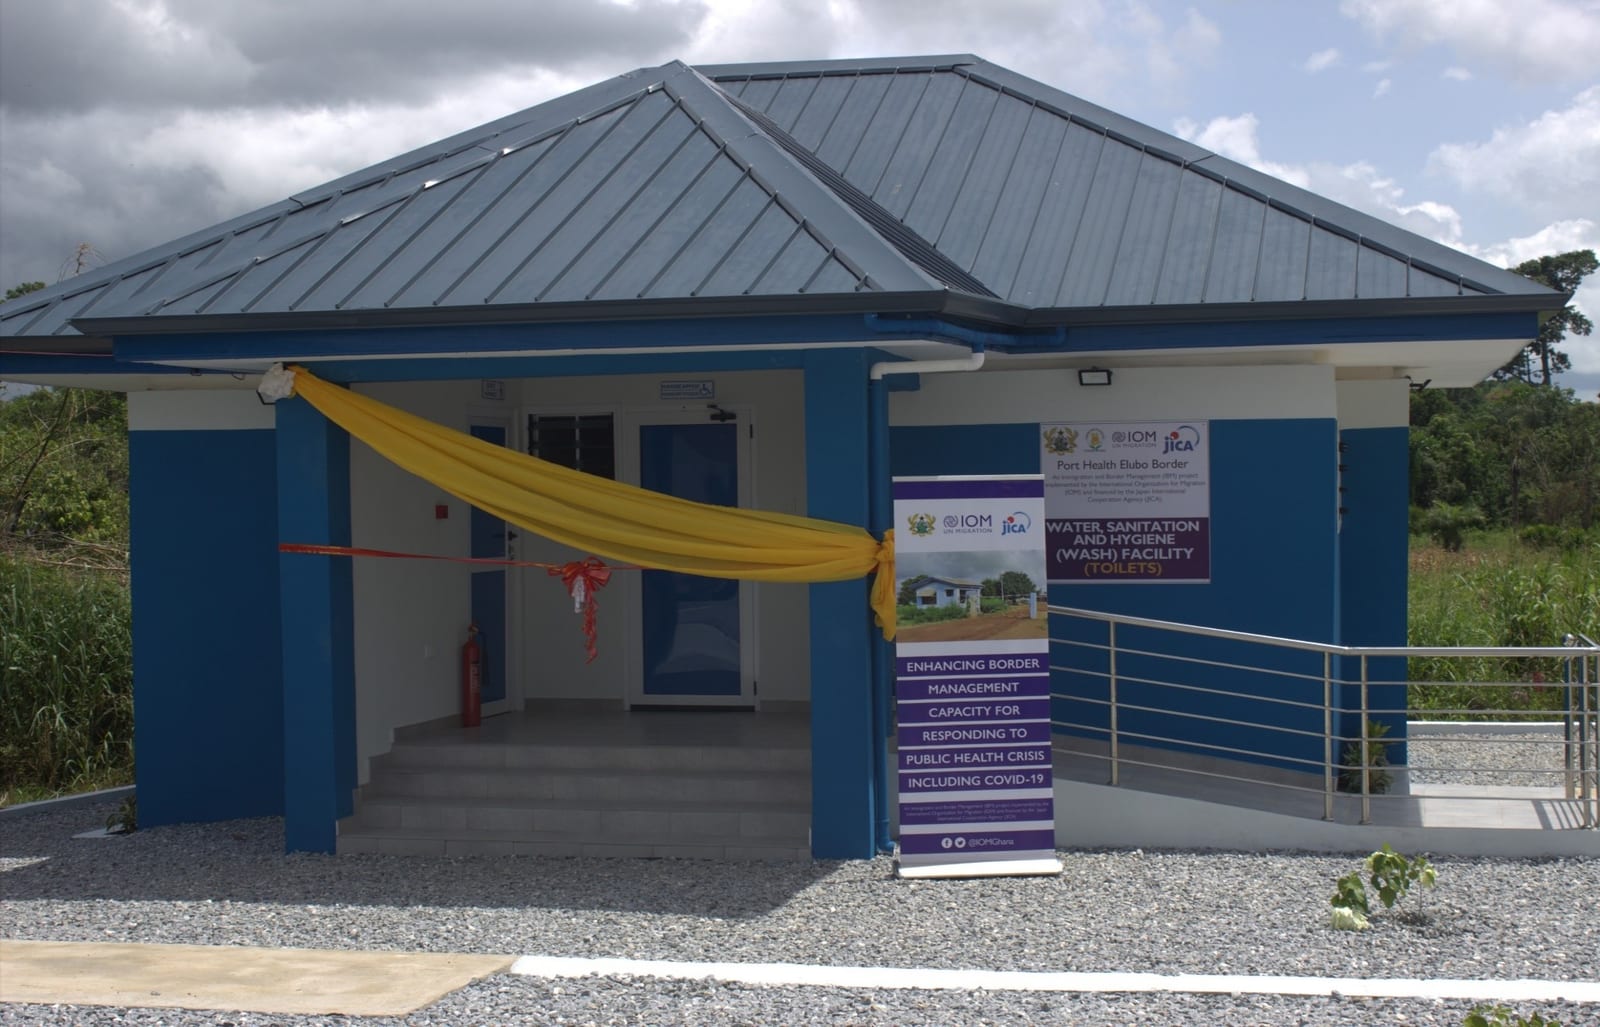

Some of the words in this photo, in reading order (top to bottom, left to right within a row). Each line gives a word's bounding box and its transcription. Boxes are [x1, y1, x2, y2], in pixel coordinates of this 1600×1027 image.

[1128, 431, 1156, 442] IOM
[1058, 460, 1080, 470] Port
[1083, 460, 1116, 470] Health
[1120, 460, 1148, 469] Elubo
[1152, 459, 1189, 469] Border
[961, 514, 992, 528] IOM
[1107, 521, 1200, 532] SANITATION
[1073, 534, 1106, 545] AND
[1110, 534, 1175, 545] HYGIENE
[1056, 548, 1117, 562] (WASH)
[1122, 548, 1194, 560] FACILITY
[1084, 562, 1162, 576] (TOILETS)
[907, 660, 985, 672] ENHANCING
[989, 659, 1040, 670] BORDER
[928, 682, 1019, 694] MANAGEMENT
[929, 706, 991, 718] CAPACITY
[995, 706, 1020, 715] FOR
[923, 729, 1006, 741] RESPONDING
[1009, 728, 1027, 738] TO
[906, 754, 950, 765] PUBLIC
[954, 752, 1004, 763] HEALTH
[1008, 751, 1045, 762] CRISIS
[908, 776, 981, 788] INCLUDING
[984, 774, 1044, 785] COVID-19
[968, 838, 1014, 847] @IOMGhana
